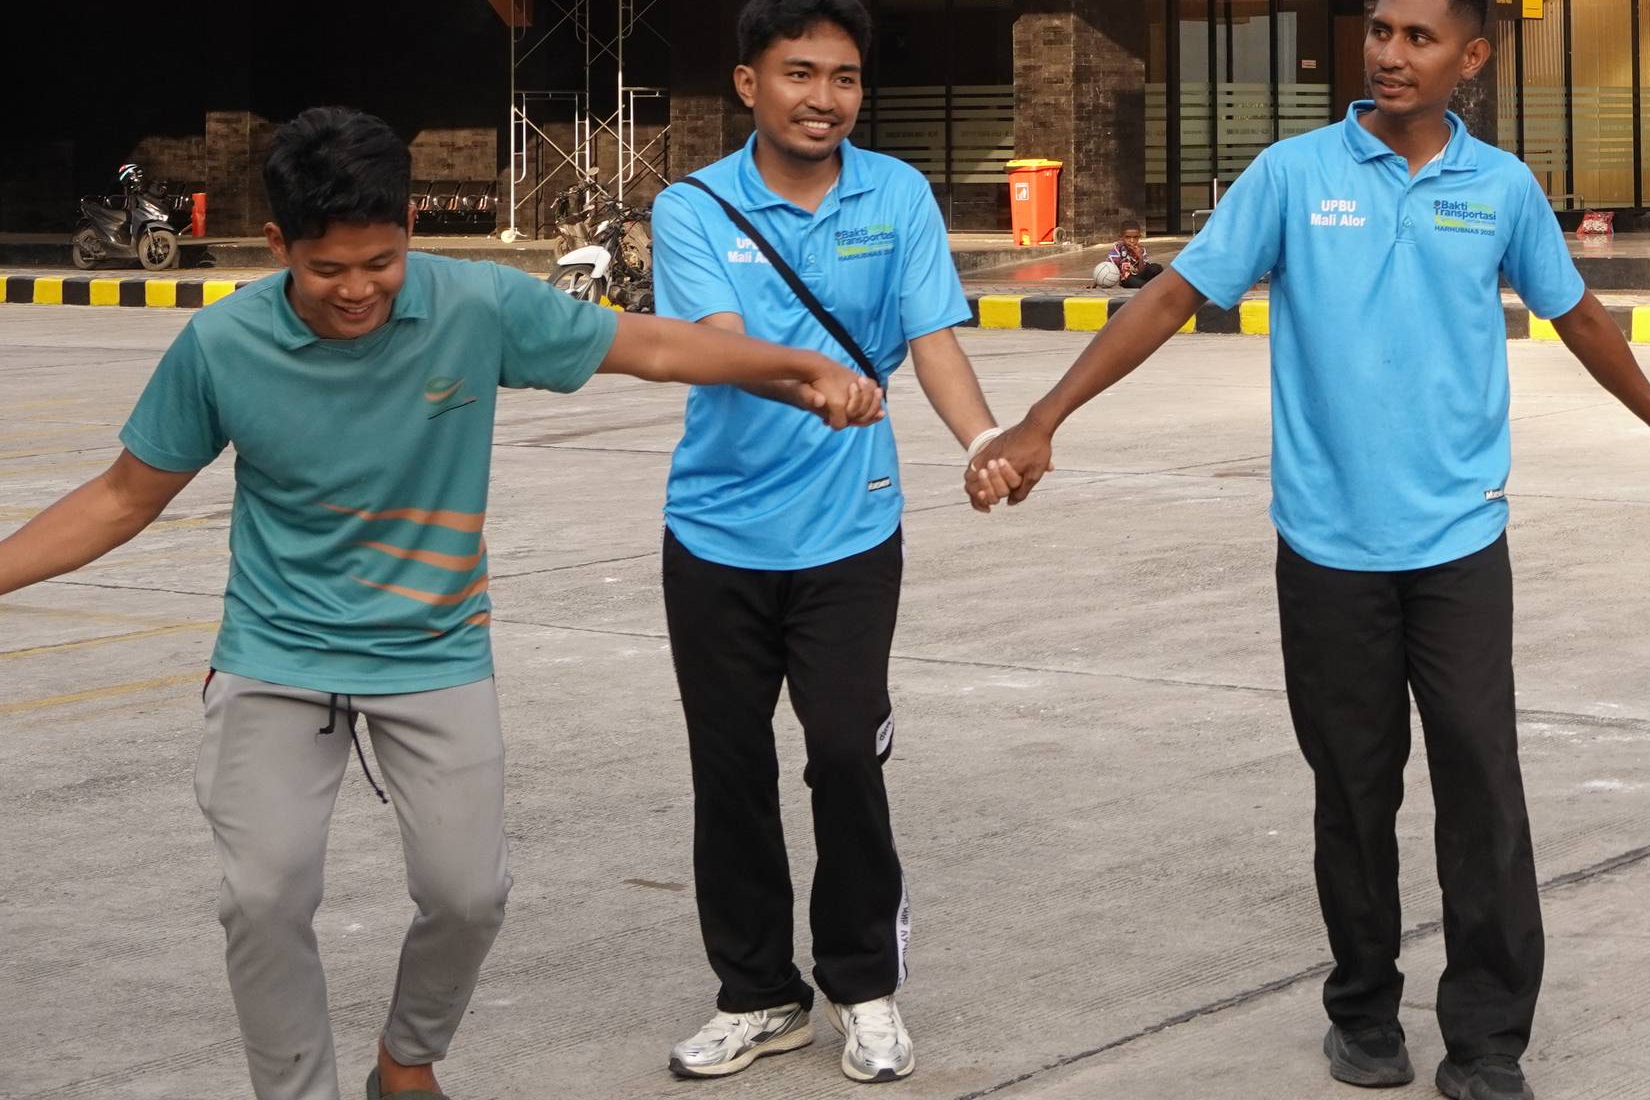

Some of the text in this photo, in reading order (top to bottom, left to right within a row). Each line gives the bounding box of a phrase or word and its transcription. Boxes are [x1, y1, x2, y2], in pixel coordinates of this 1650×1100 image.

[1321, 200, 1356, 212] UPBU
[1441, 200, 1468, 210] Bakti
[1434, 207, 1496, 220] Transportasi
[1310, 213, 1366, 227] Mali Alor
[727, 251, 752, 263] Mali
